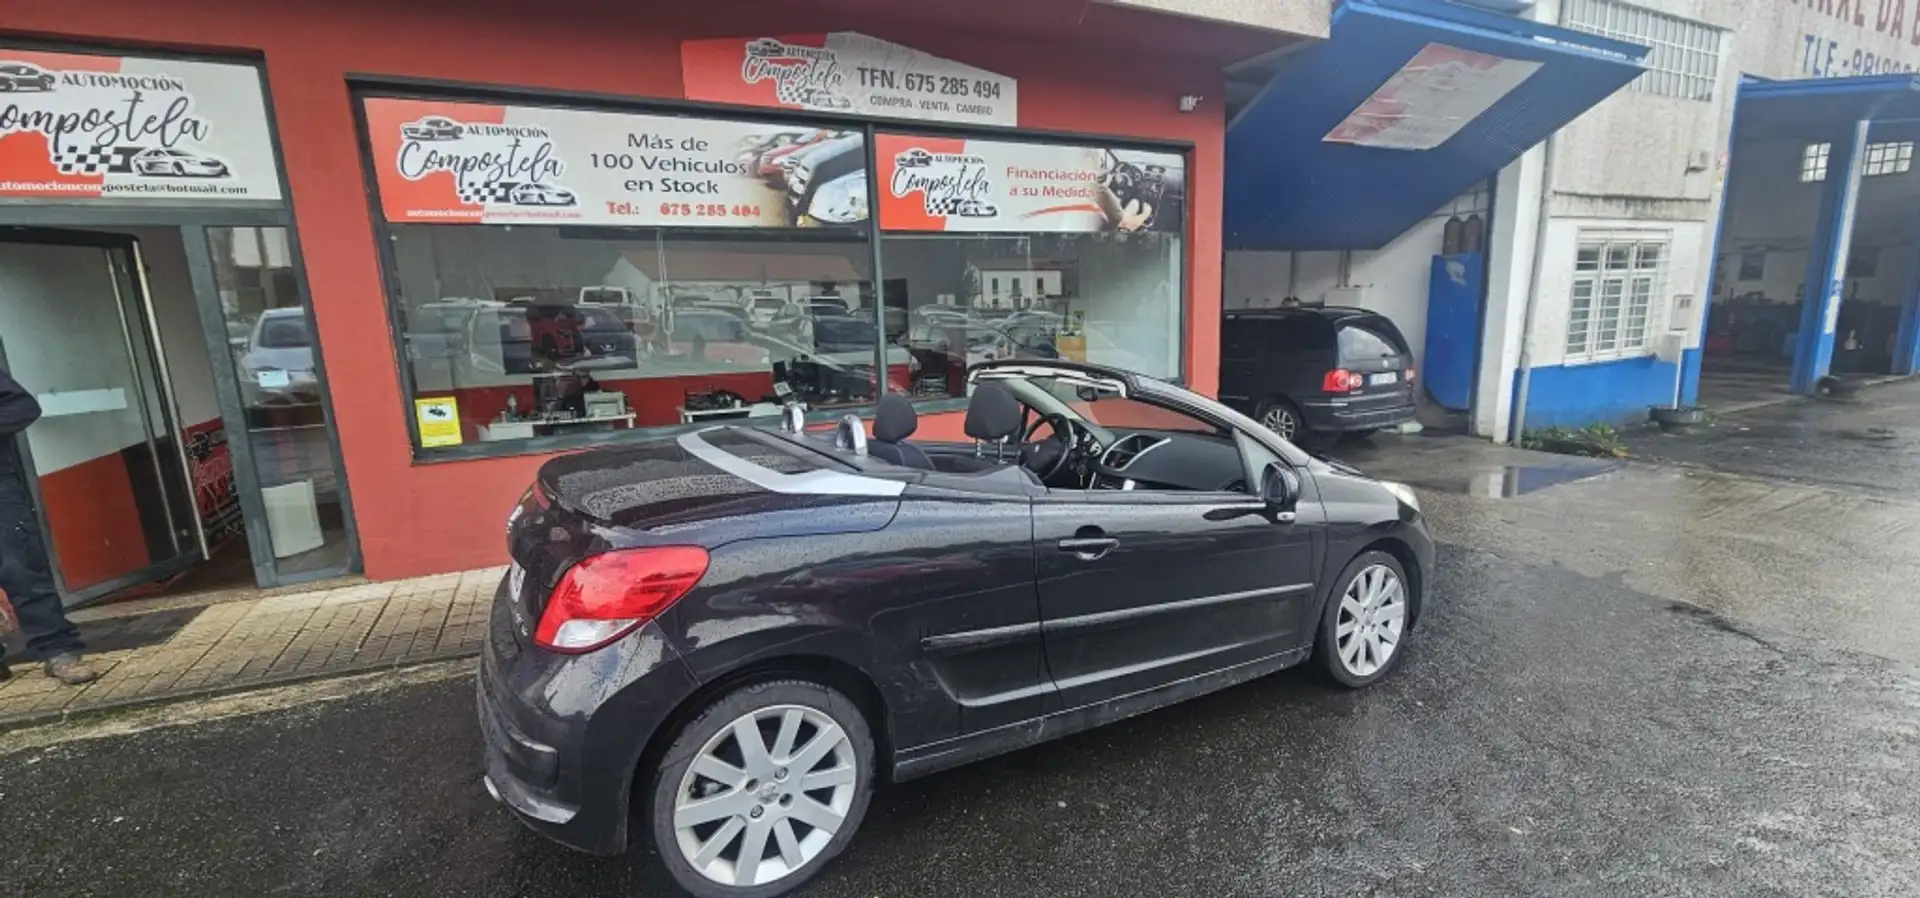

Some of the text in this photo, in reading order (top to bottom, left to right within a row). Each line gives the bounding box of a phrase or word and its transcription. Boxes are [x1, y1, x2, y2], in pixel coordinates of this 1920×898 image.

[61, 73, 185, 92] AUTOMOCIÓN
[744, 56, 843, 96] Compostela
[857, 67, 1001, 99] TFN. 675 285 494
[869, 95, 913, 109] COMPRA
[955, 103, 993, 115] CAMBIO
[0, 91, 208, 153] ompostela
[466, 125, 549, 138] AUTOMOCIÓN
[627, 133, 708, 151] Más de
[400, 139, 563, 191] Compostela
[590, 153, 634, 169] 100
[1006, 165, 1097, 182] Financiación
[624, 178, 719, 194] en Stock
[894, 163, 990, 204] Compostela
[1008, 185, 1095, 199] a su Medida
[659, 202, 691, 216] 675
[695, 203, 727, 217] 285
